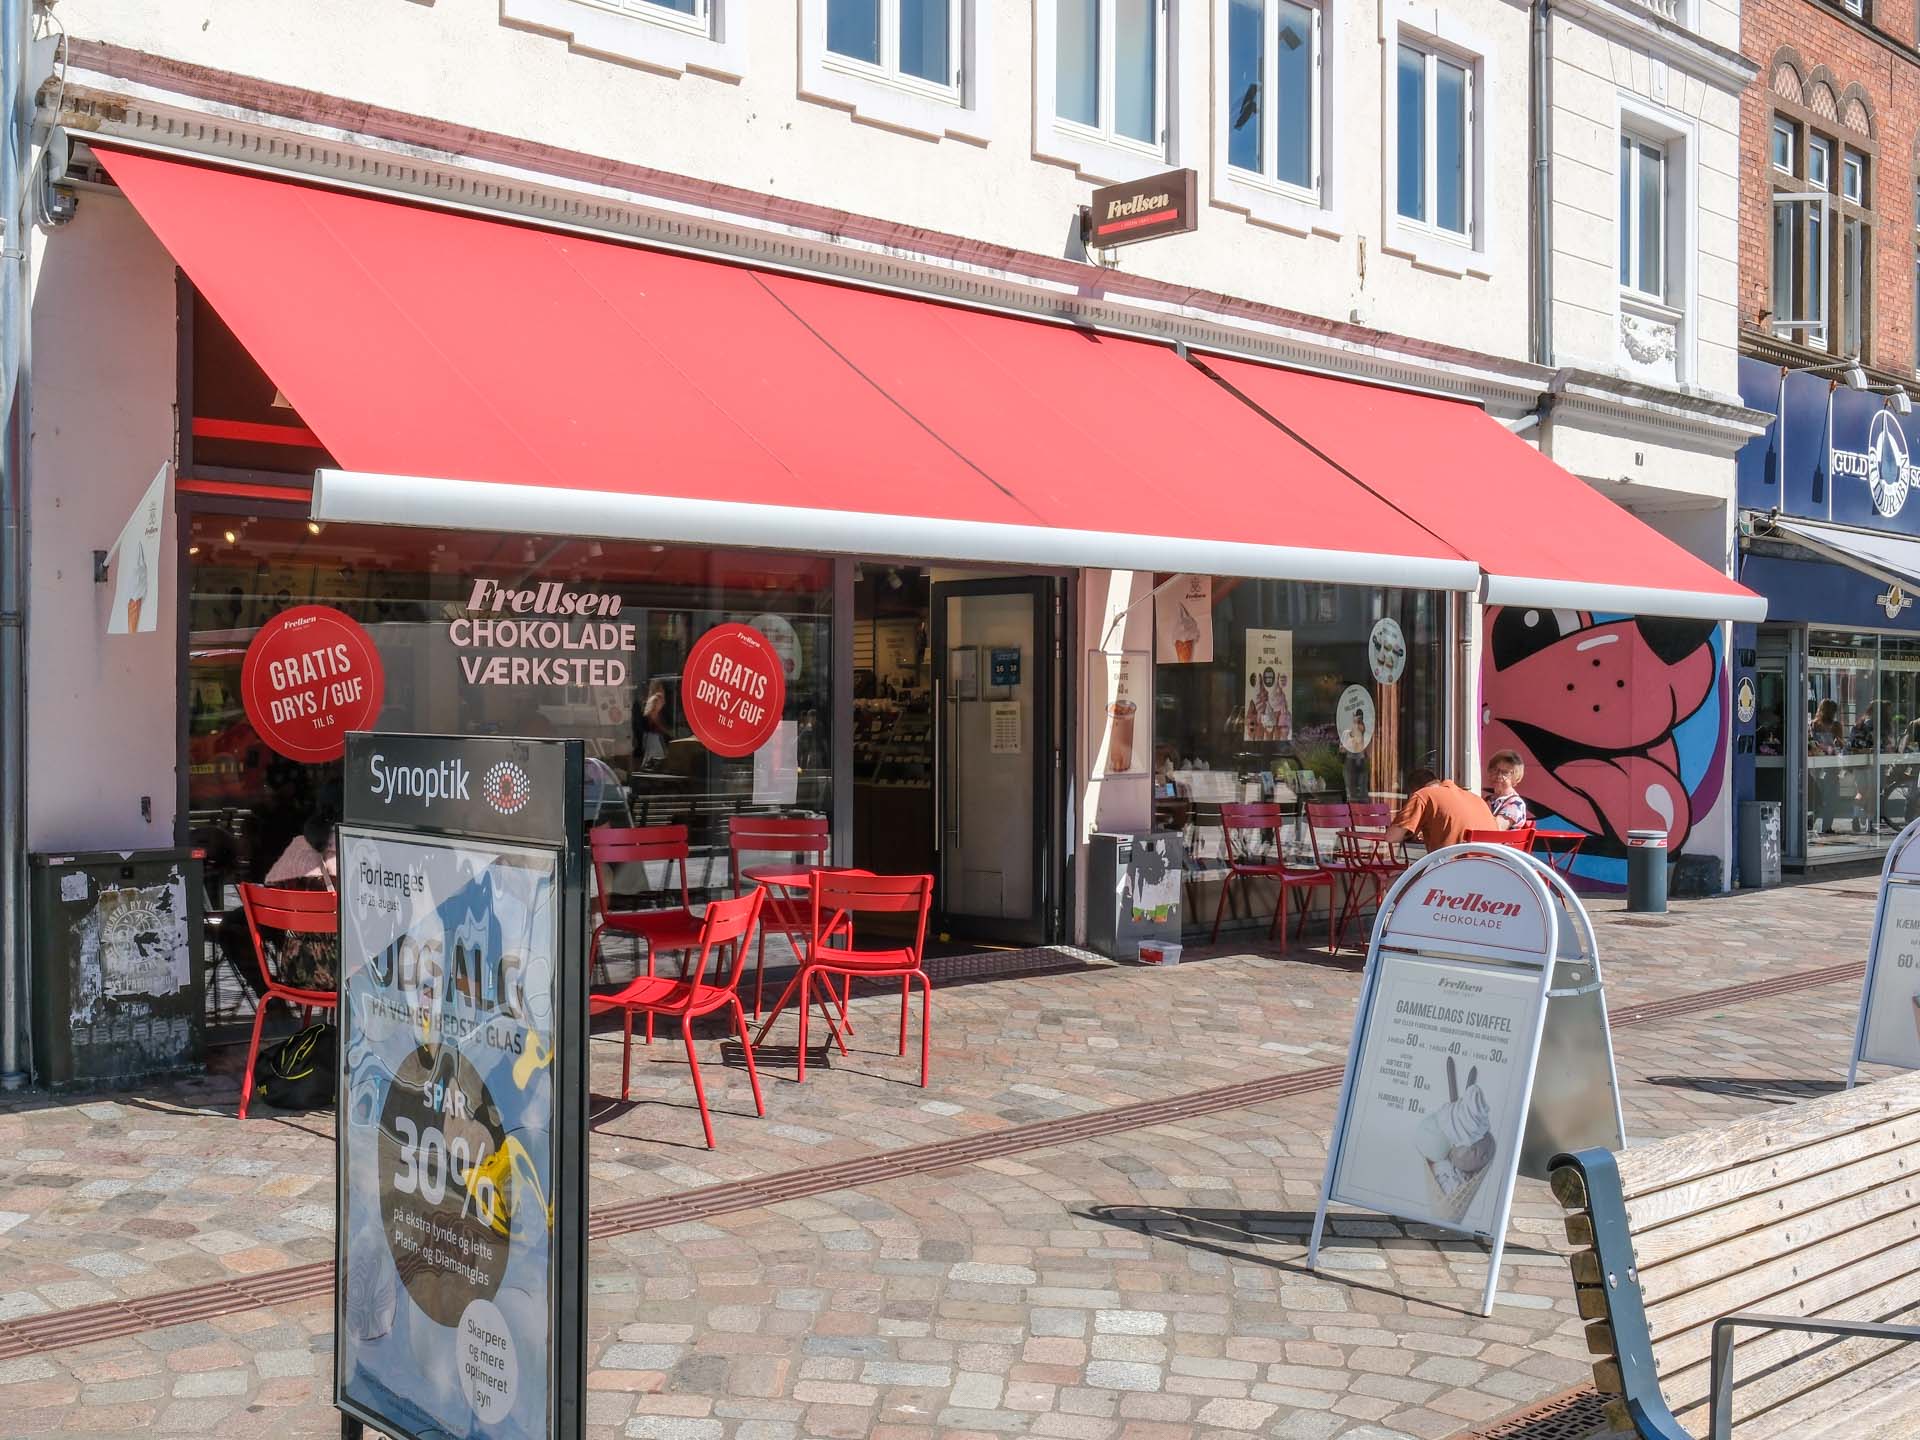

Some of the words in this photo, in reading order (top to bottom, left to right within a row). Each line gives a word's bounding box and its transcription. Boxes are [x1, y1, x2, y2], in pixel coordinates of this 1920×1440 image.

[1106, 193, 1169, 219] Frellsen
[1833, 452, 1868, 477] GULD
[466, 578, 622, 616] Frellsen
[284, 616, 316, 630] Frellsen
[449, 618, 636, 651] CHOKOLADE
[269, 643, 351, 692] GRATIS
[460, 656, 626, 686] VÆRKSTED
[709, 652, 768, 700] GRATIS
[270, 690, 318, 724] DRYS
[321, 686, 328, 710] /
[331, 677, 364, 706] GUF
[696, 679, 731, 711] DRYS
[730, 697, 742, 714] /
[739, 699, 765, 726] GUF
[312, 717, 326, 729] TIL
[326, 714, 335, 725] IS
[718, 714, 727, 726] TIL
[370, 754, 470, 807] Synoptik
[359, 861, 425, 897] Forlænges
[1421, 888, 1521, 917] Frellsen
[1432, 912, 1503, 929] CHOKOLADE
[1897, 953, 1914, 969] 60
[1438, 977, 1483, 993] Frellsen
[1396, 999, 1464, 1025] GAMMELDAGS
[1465, 1011, 1512, 1033] ISVAFFEL
[486, 1025, 522, 1054] GLAS
[1406, 1033, 1419, 1047] 50
[1448, 1041, 1461, 1055] 40
[1489, 1048, 1503, 1063] 30
[1413, 1075, 1424, 1089] 10
[423, 1080, 466, 1120] SPAR
[1408, 1098, 1419, 1112] 10
[393, 1116, 495, 1230] 30%
[393, 1206, 404, 1223] på
[405, 1211, 431, 1234] ekstra
[432, 1223, 457, 1245] tynde
[458, 1236, 469, 1256] og
[471, 1237, 493, 1260] lette
[395, 1229, 420, 1254] Platin-
[422, 1247, 433, 1265] og
[435, 1248, 489, 1286] Diamantglas
[467, 1319, 507, 1351] Skarpere
[468, 1342, 478, 1358] og
[480, 1350, 505, 1371] mere
[465, 1362, 508, 1395] optimeret
[476, 1391, 492, 1408] syn
